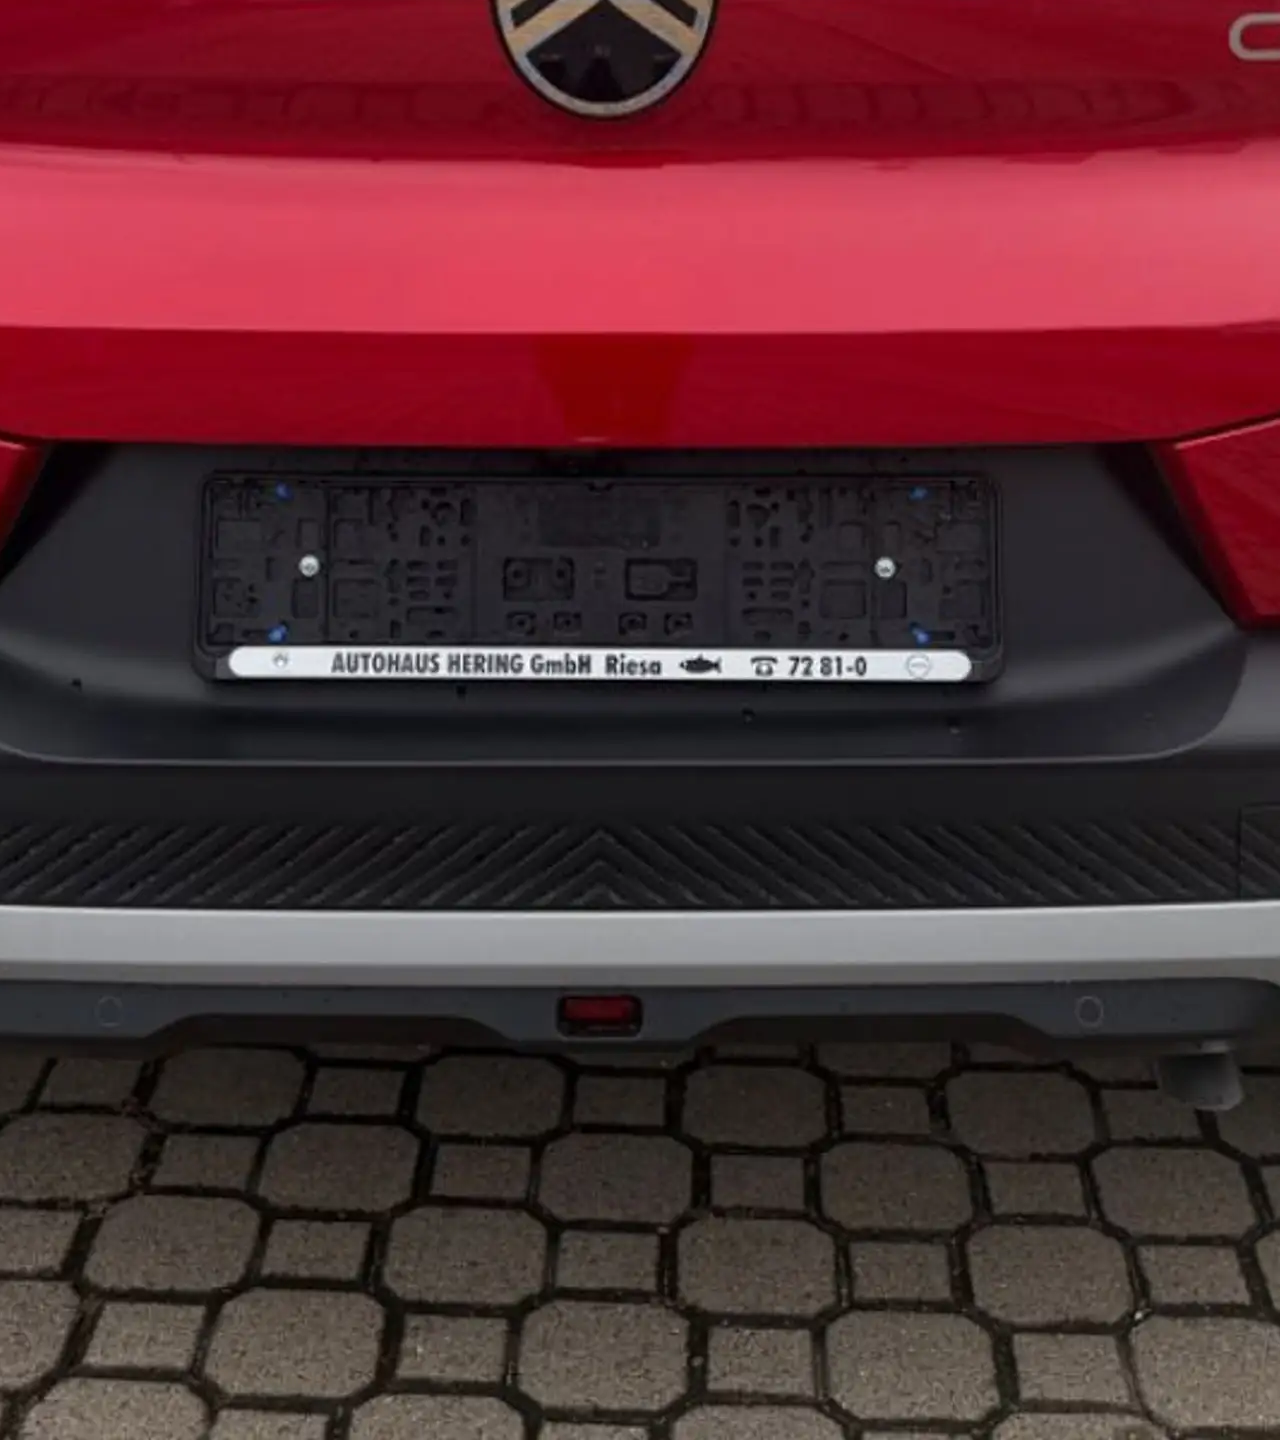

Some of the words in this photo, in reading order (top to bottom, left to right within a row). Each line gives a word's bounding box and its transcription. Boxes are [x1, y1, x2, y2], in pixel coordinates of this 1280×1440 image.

[331, 652, 440, 674] AUTOHAUS
[447, 652, 524, 674] HERING
[530, 652, 592, 675] GmbH
[605, 654, 663, 676] Riesa
